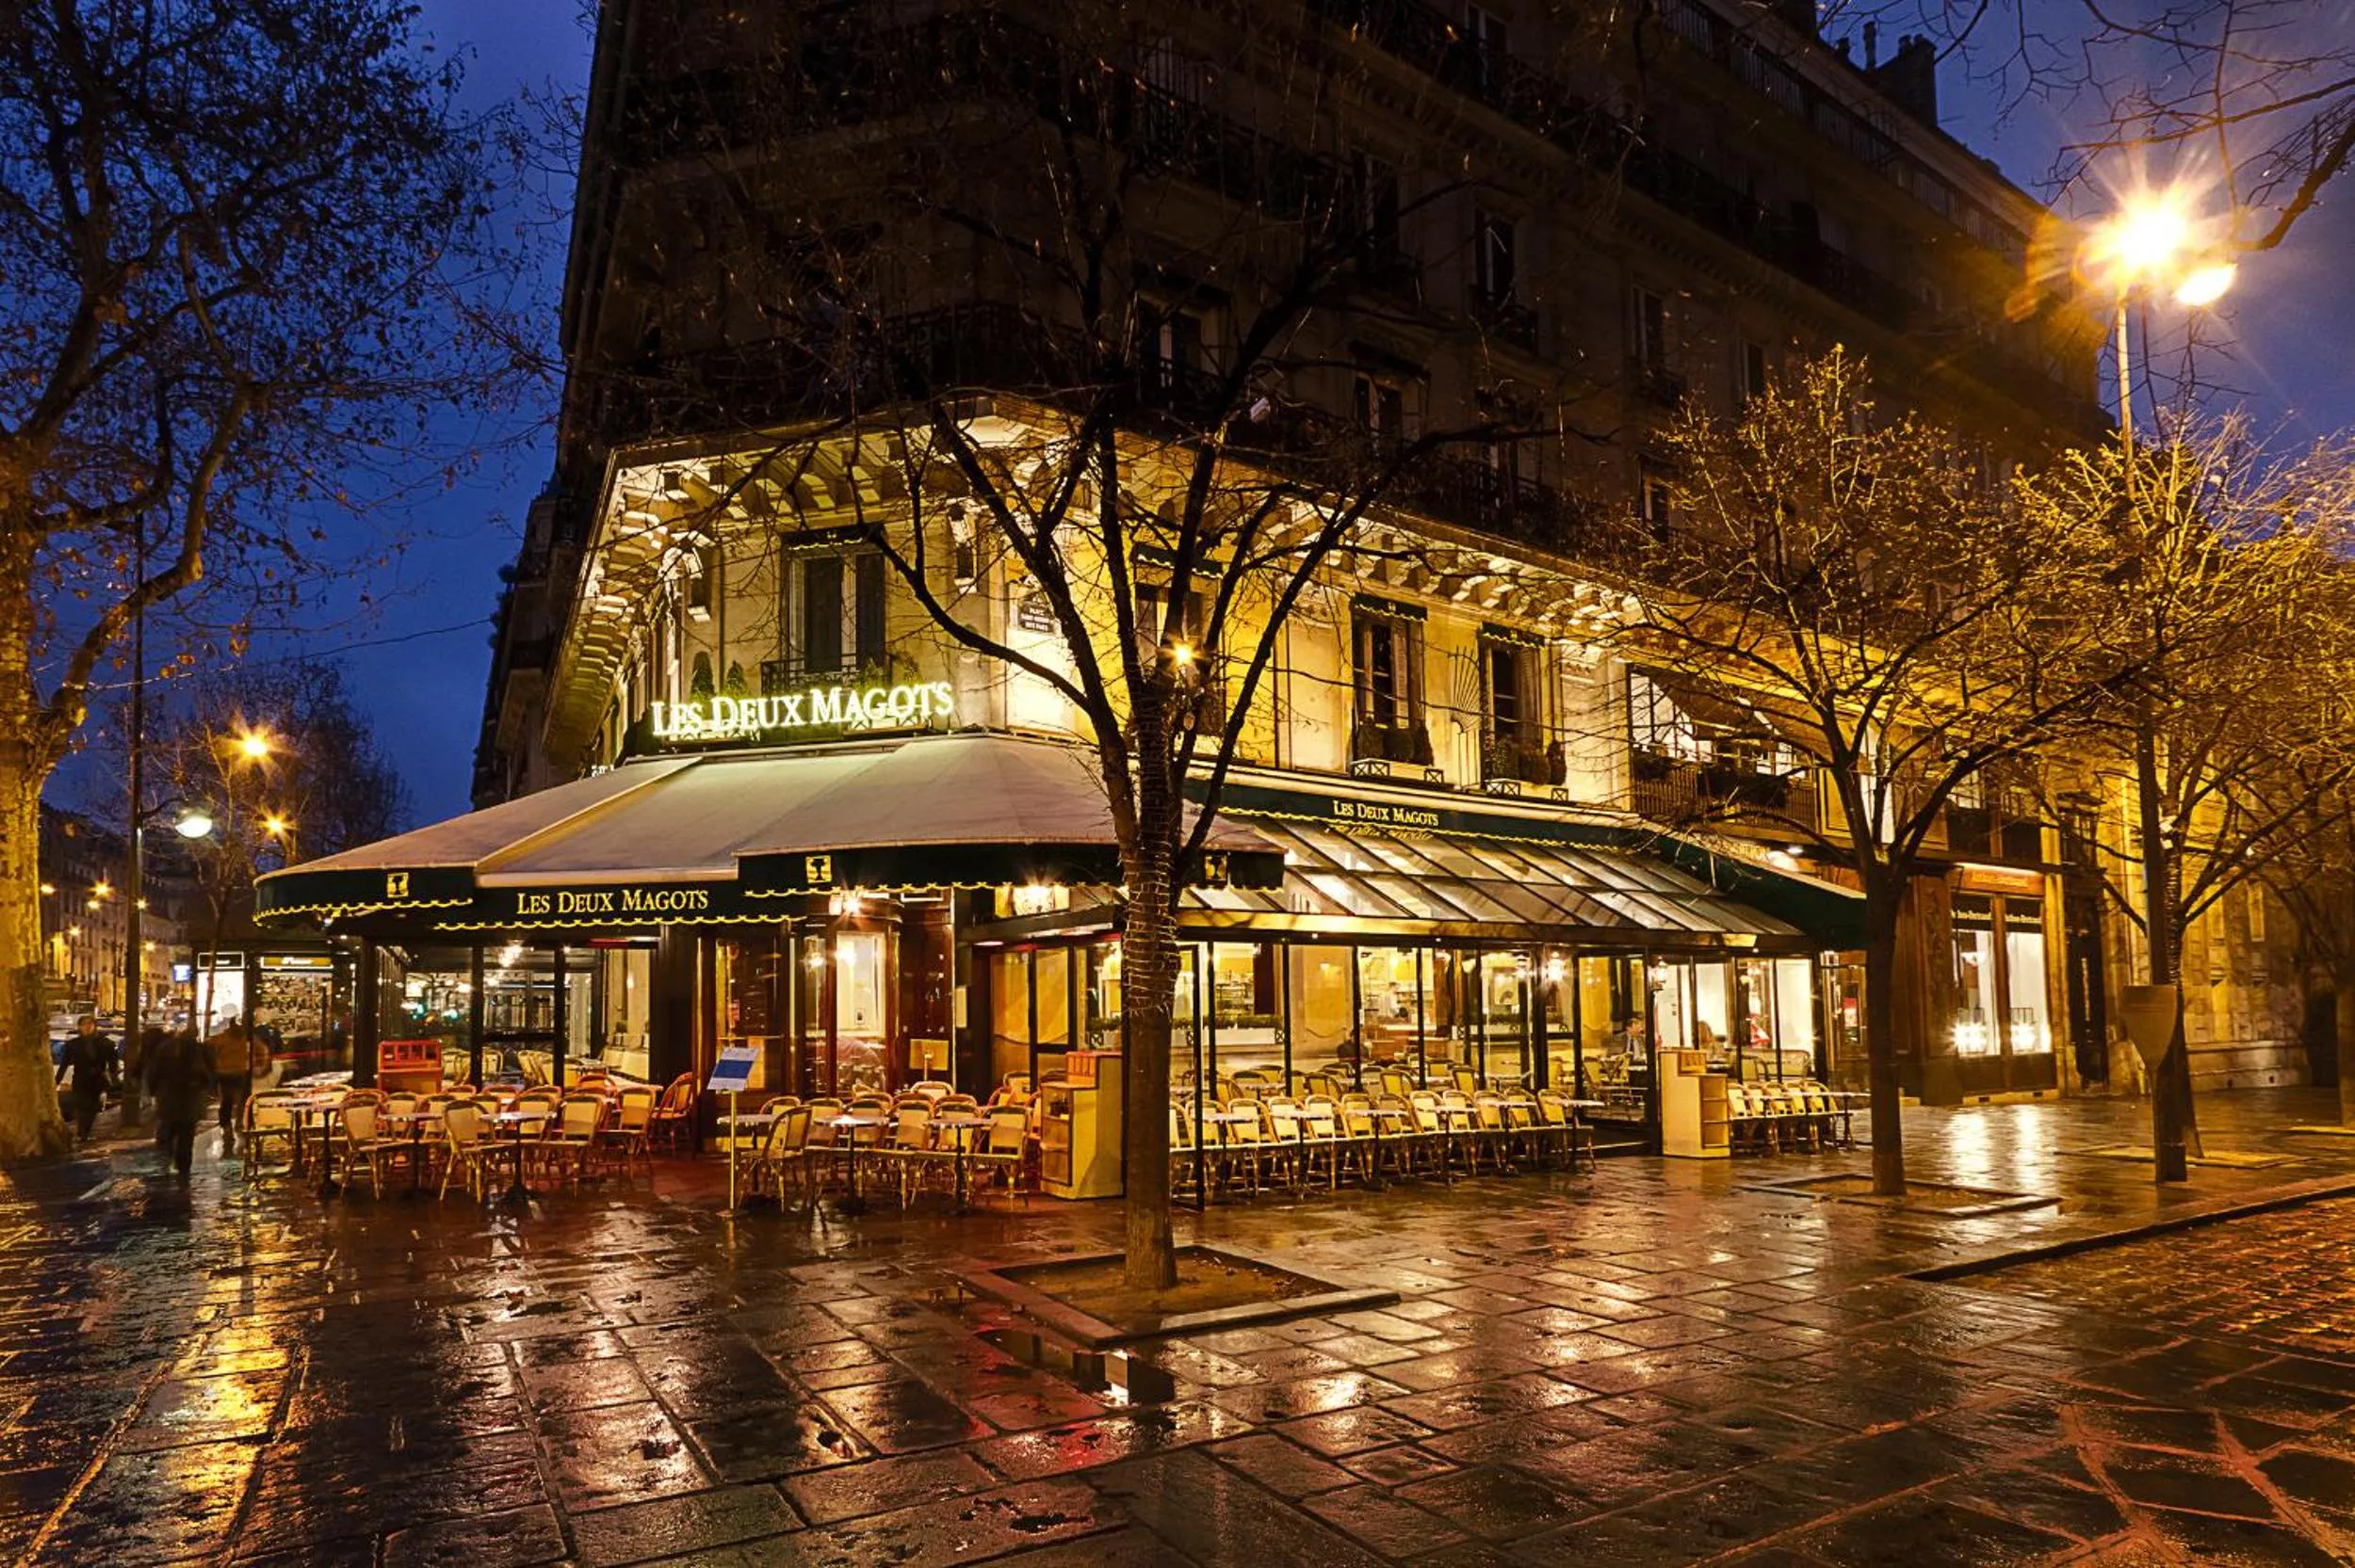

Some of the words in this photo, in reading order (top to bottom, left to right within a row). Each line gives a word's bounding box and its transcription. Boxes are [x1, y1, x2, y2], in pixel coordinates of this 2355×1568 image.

[651, 701, 704, 736] LES
[710, 696, 804, 731] DEUX
[810, 681, 953, 724] MAGOTS
[1333, 800, 1355, 816] LES
[1356, 803, 1389, 821] DEUX
[1392, 808, 1438, 826] MAGOTS
[517, 893, 550, 914] LES
[558, 891, 614, 913] DEUX
[622, 889, 708, 911] MAGOTS
